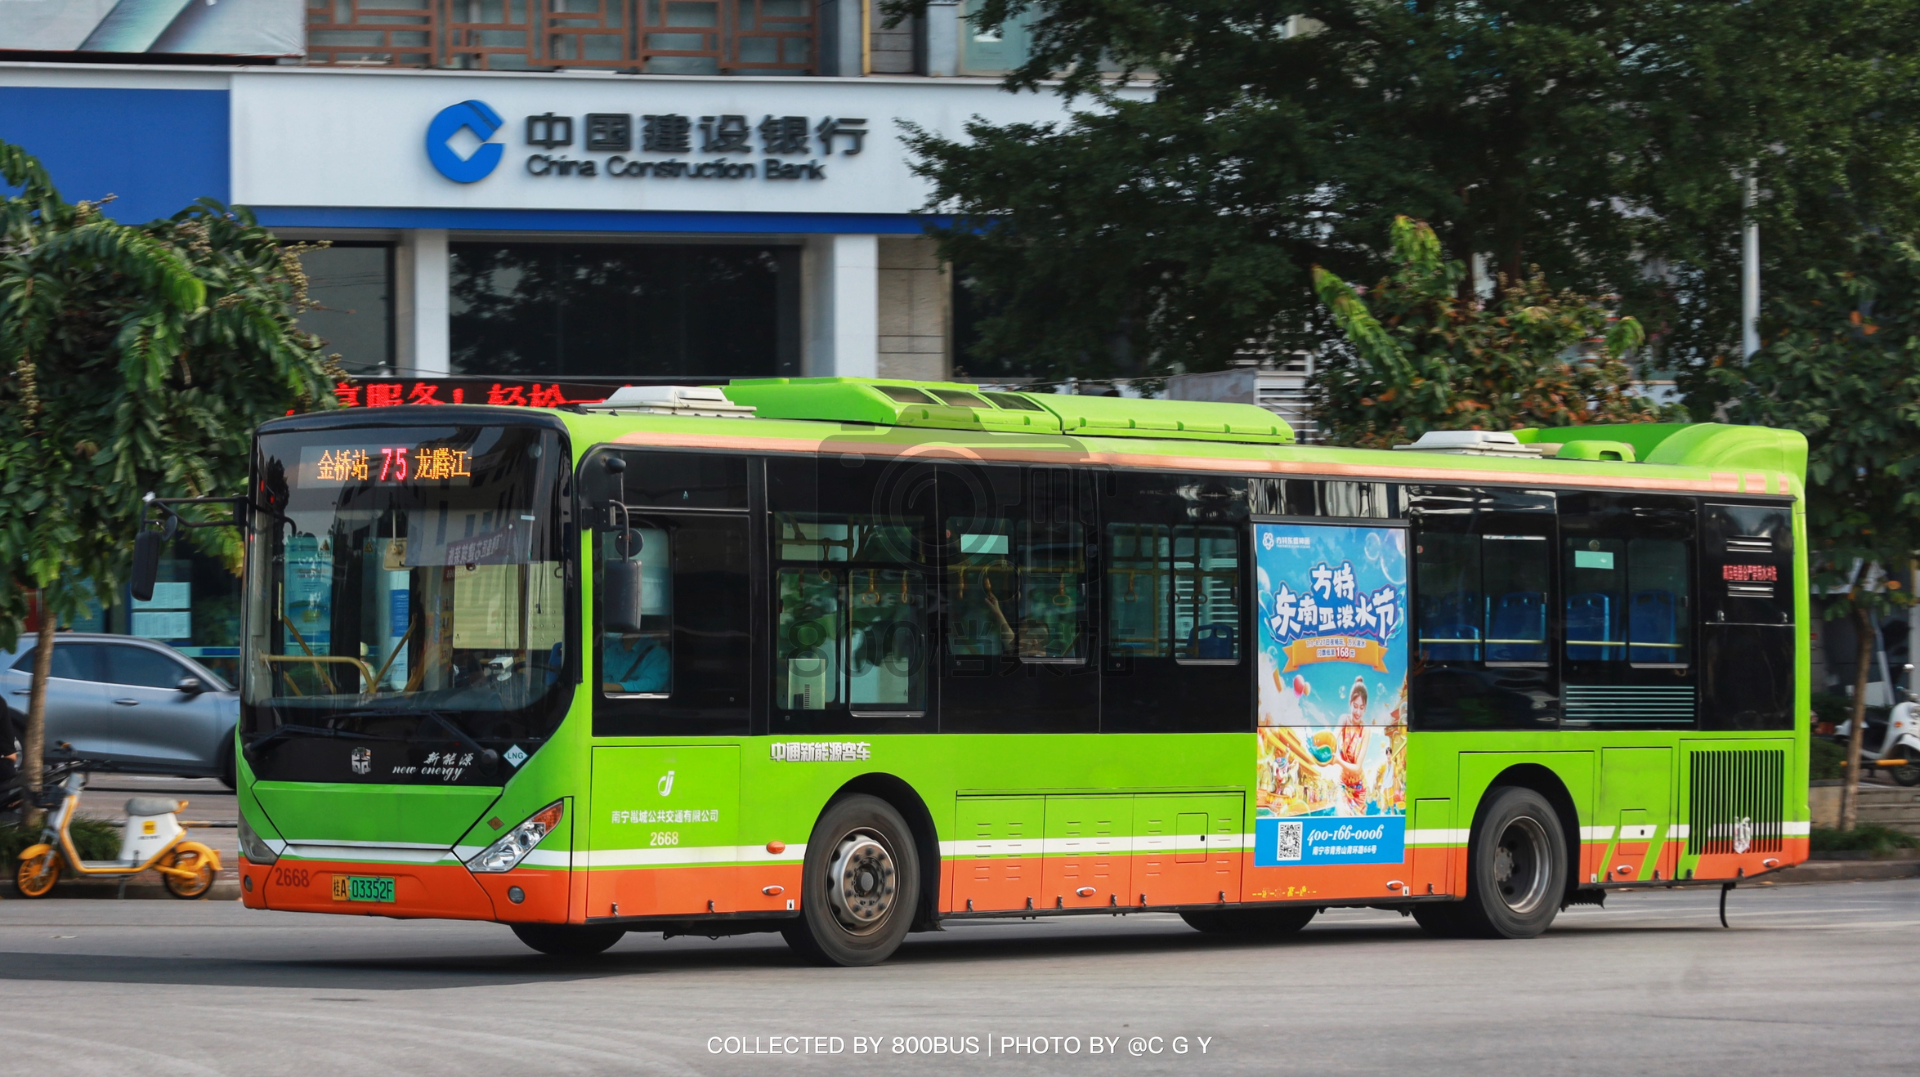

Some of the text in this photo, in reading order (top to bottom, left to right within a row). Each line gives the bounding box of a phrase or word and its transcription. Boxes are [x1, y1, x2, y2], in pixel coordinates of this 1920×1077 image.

[525, 112, 868, 154] 中国建设银行
[525, 154, 826, 180] China Construction Bank
[316, 449, 369, 481] 金桥站
[379, 447, 408, 481] 75
[1311, 562, 1355, 600] 方特
[1270, 584, 1395, 640] 东南亚泼水节
[423, 751, 474, 766] 新能源
[507, 750, 523, 759] LNG
[392, 764, 465, 781] new energy
[611, 809, 719, 824] 南宁邕城公共交通有限公司
[650, 831, 679, 846] 2668
[1307, 824, 1384, 846] 400-166-0006
[275, 867, 310, 888] 2668
